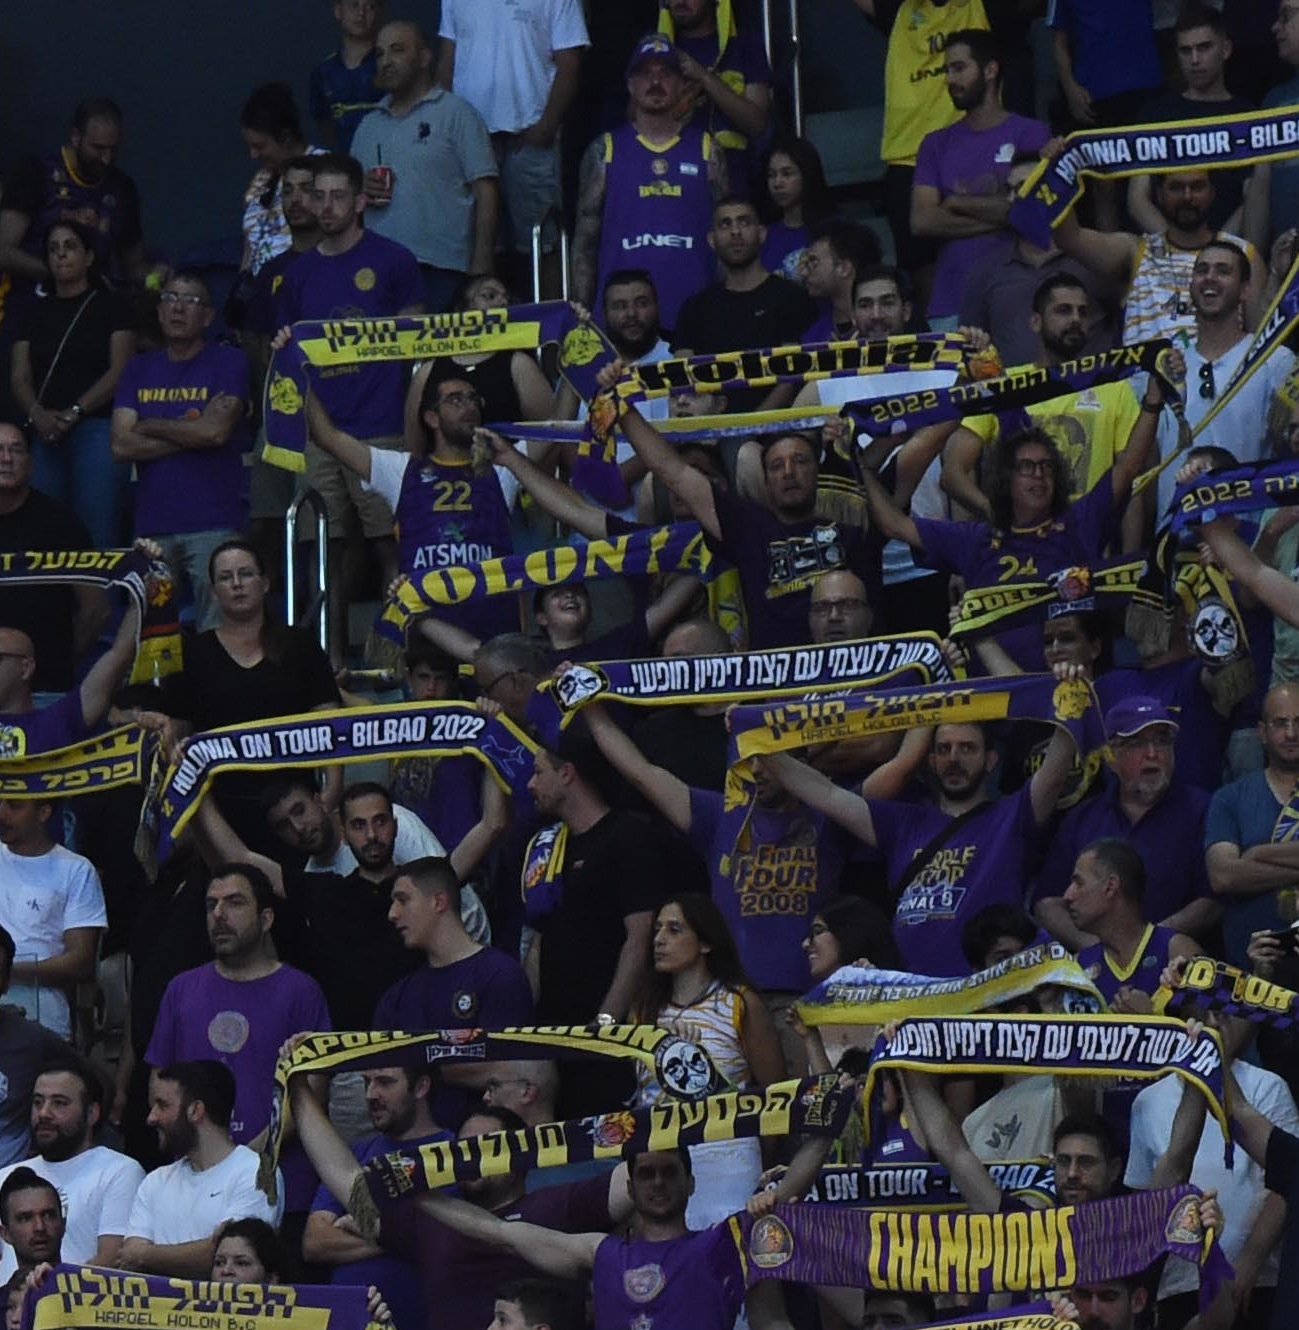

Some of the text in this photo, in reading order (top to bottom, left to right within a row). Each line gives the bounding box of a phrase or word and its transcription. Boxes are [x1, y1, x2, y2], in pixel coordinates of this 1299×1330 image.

[1055, 135, 1130, 185] HOLONIA
[1137, 134, 1169, 161] ON
[1172, 129, 1231, 159] TOUR
[321, 307, 509, 353] הפועל חולון
[356, 341, 454, 359] HAPOEL HOLON
[871, 345, 1146, 423] אלופת 2022
[431, 480, 474, 513] 22
[1181, 478, 1254, 512] 2022
[28, 550, 126, 572] הפועל
[413, 543, 494, 571] ATSMON
[699, 644, 889, 693] לעצמי עם קצת דימיון
[172, 713, 486, 797] HOLONIA ON TOUR BILBAO 2022
[757, 843, 818, 865] FINAL
[734, 861, 816, 892] FOUR
[740, 891, 809, 917] 2008
[945, 1021, 1135, 1063] לעצמי עם קצת דימיון
[827, 1167, 928, 1202] ON TOUR
[868, 1206, 1076, 1293] CHAMPIONS
[54, 1271, 298, 1320] הפועל חולון
[94, 1309, 160, 1326] HAPOEL
[166, 1313, 222, 1330] HOLON
